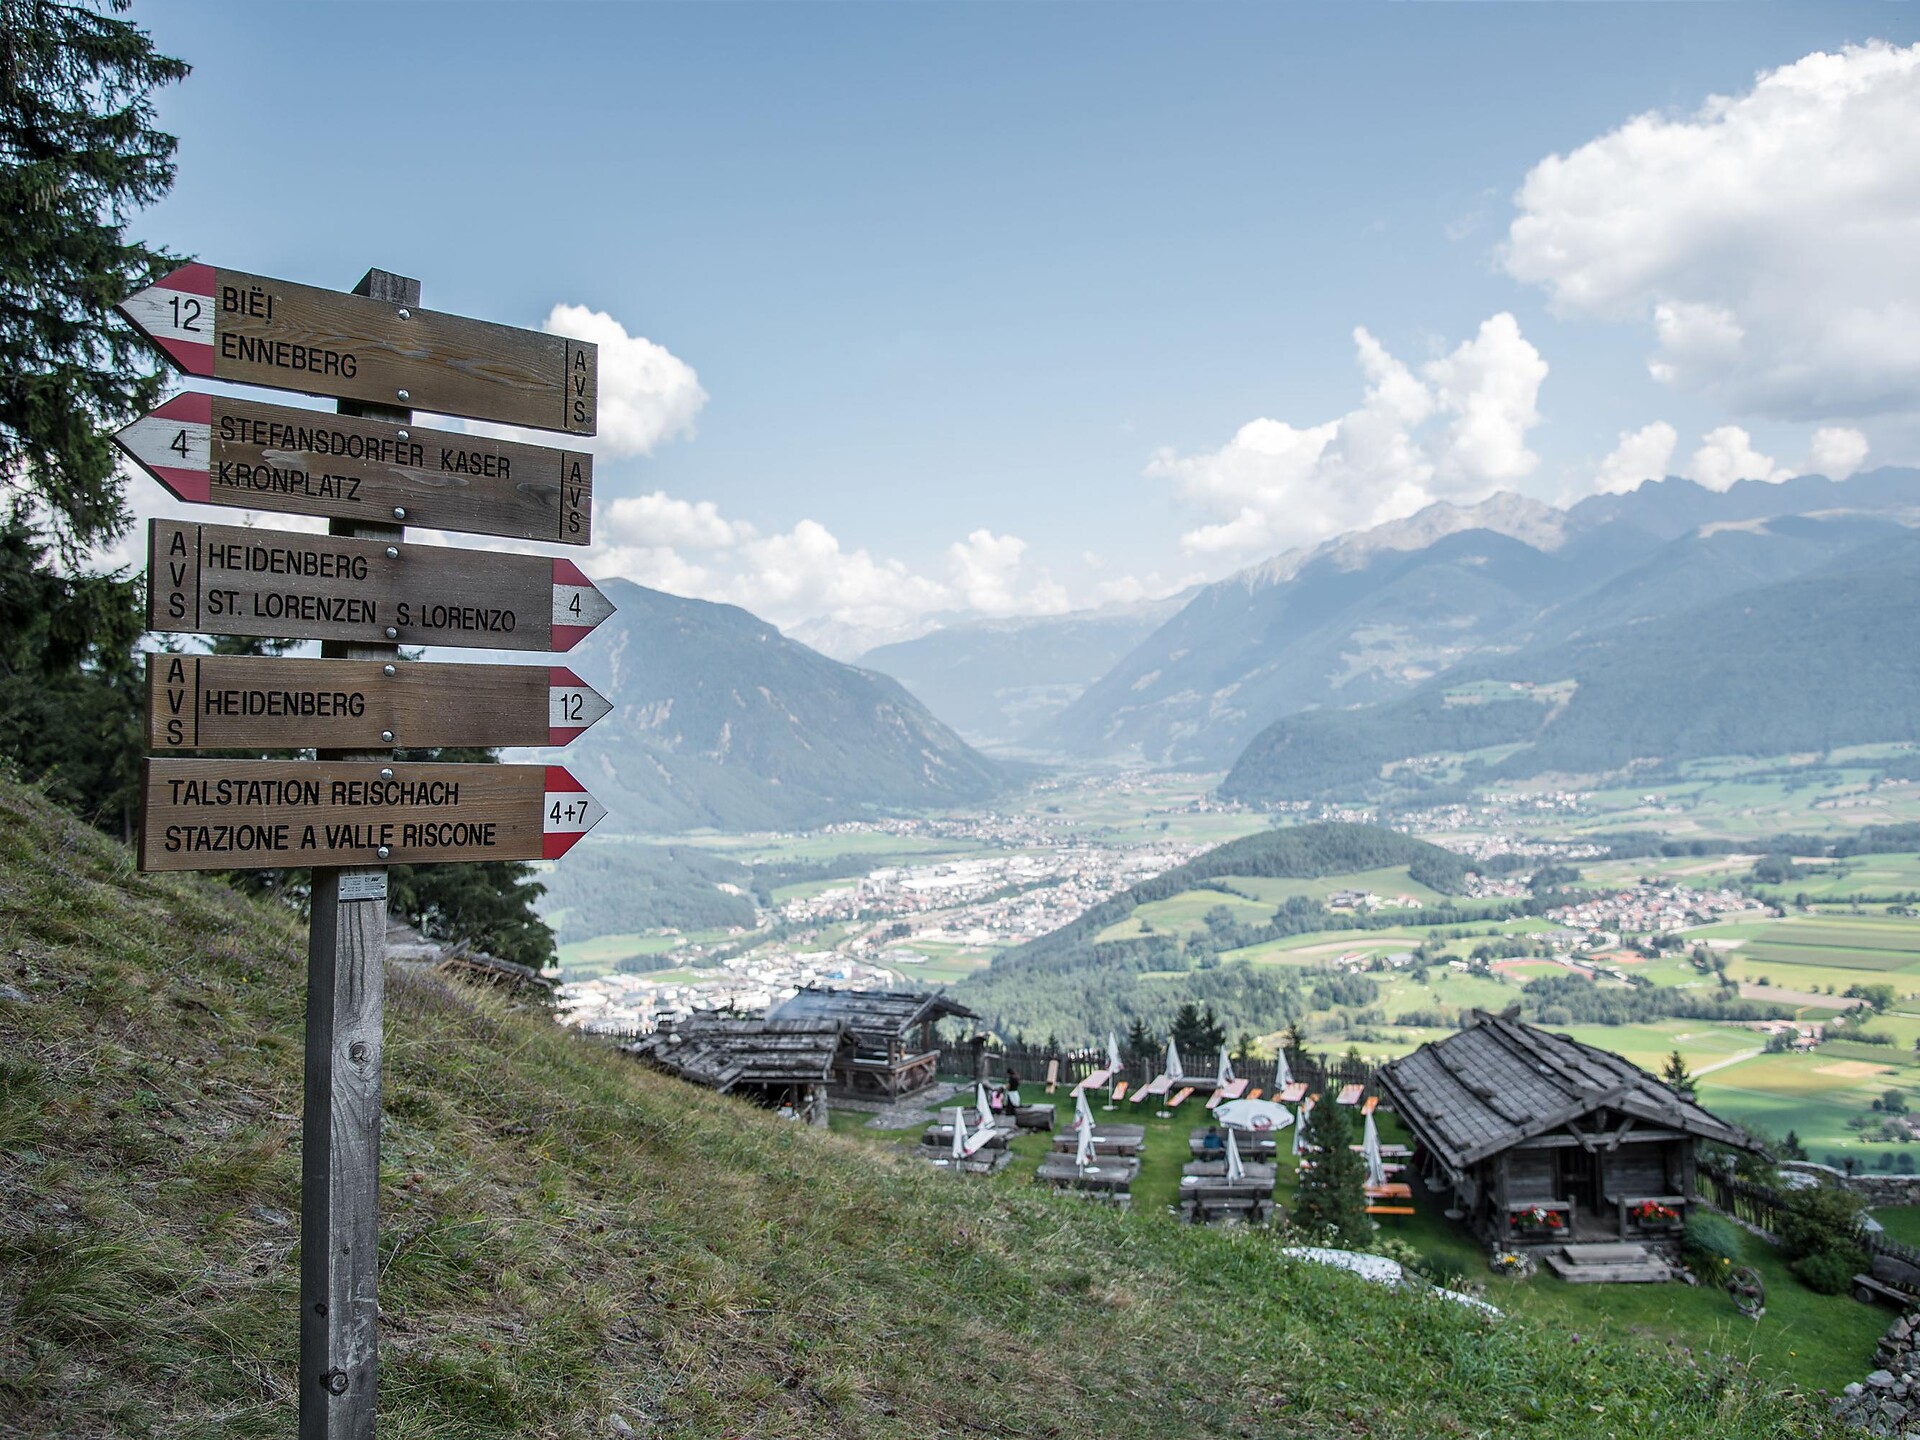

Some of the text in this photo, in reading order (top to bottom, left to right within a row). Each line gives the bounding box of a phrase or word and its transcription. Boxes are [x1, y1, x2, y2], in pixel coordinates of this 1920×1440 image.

[168, 295, 202, 333] 12
[221, 332, 357, 379] ENNEBERG
[170, 429, 190, 459] 4
[219, 415, 511, 480] STEFANSDORFER KASER
[218, 461, 362, 501] KRONPLATZ
[568, 461, 583, 534] AVS
[168, 531, 188, 619] AVS
[208, 543, 368, 581] HEIDENBERG
[207, 589, 516, 633] ST. LORENZEN S. LORENZO
[568, 592, 582, 618] 4
[166, 657, 185, 746] AVS
[205, 689, 366, 718] HEIDENBERG
[560, 693, 583, 721] 12
[167, 779, 459, 806] TALSTATION REISCHACH
[549, 800, 589, 825] 4+7
[164, 822, 497, 852] STAZIONE A VALLE RISCONE
